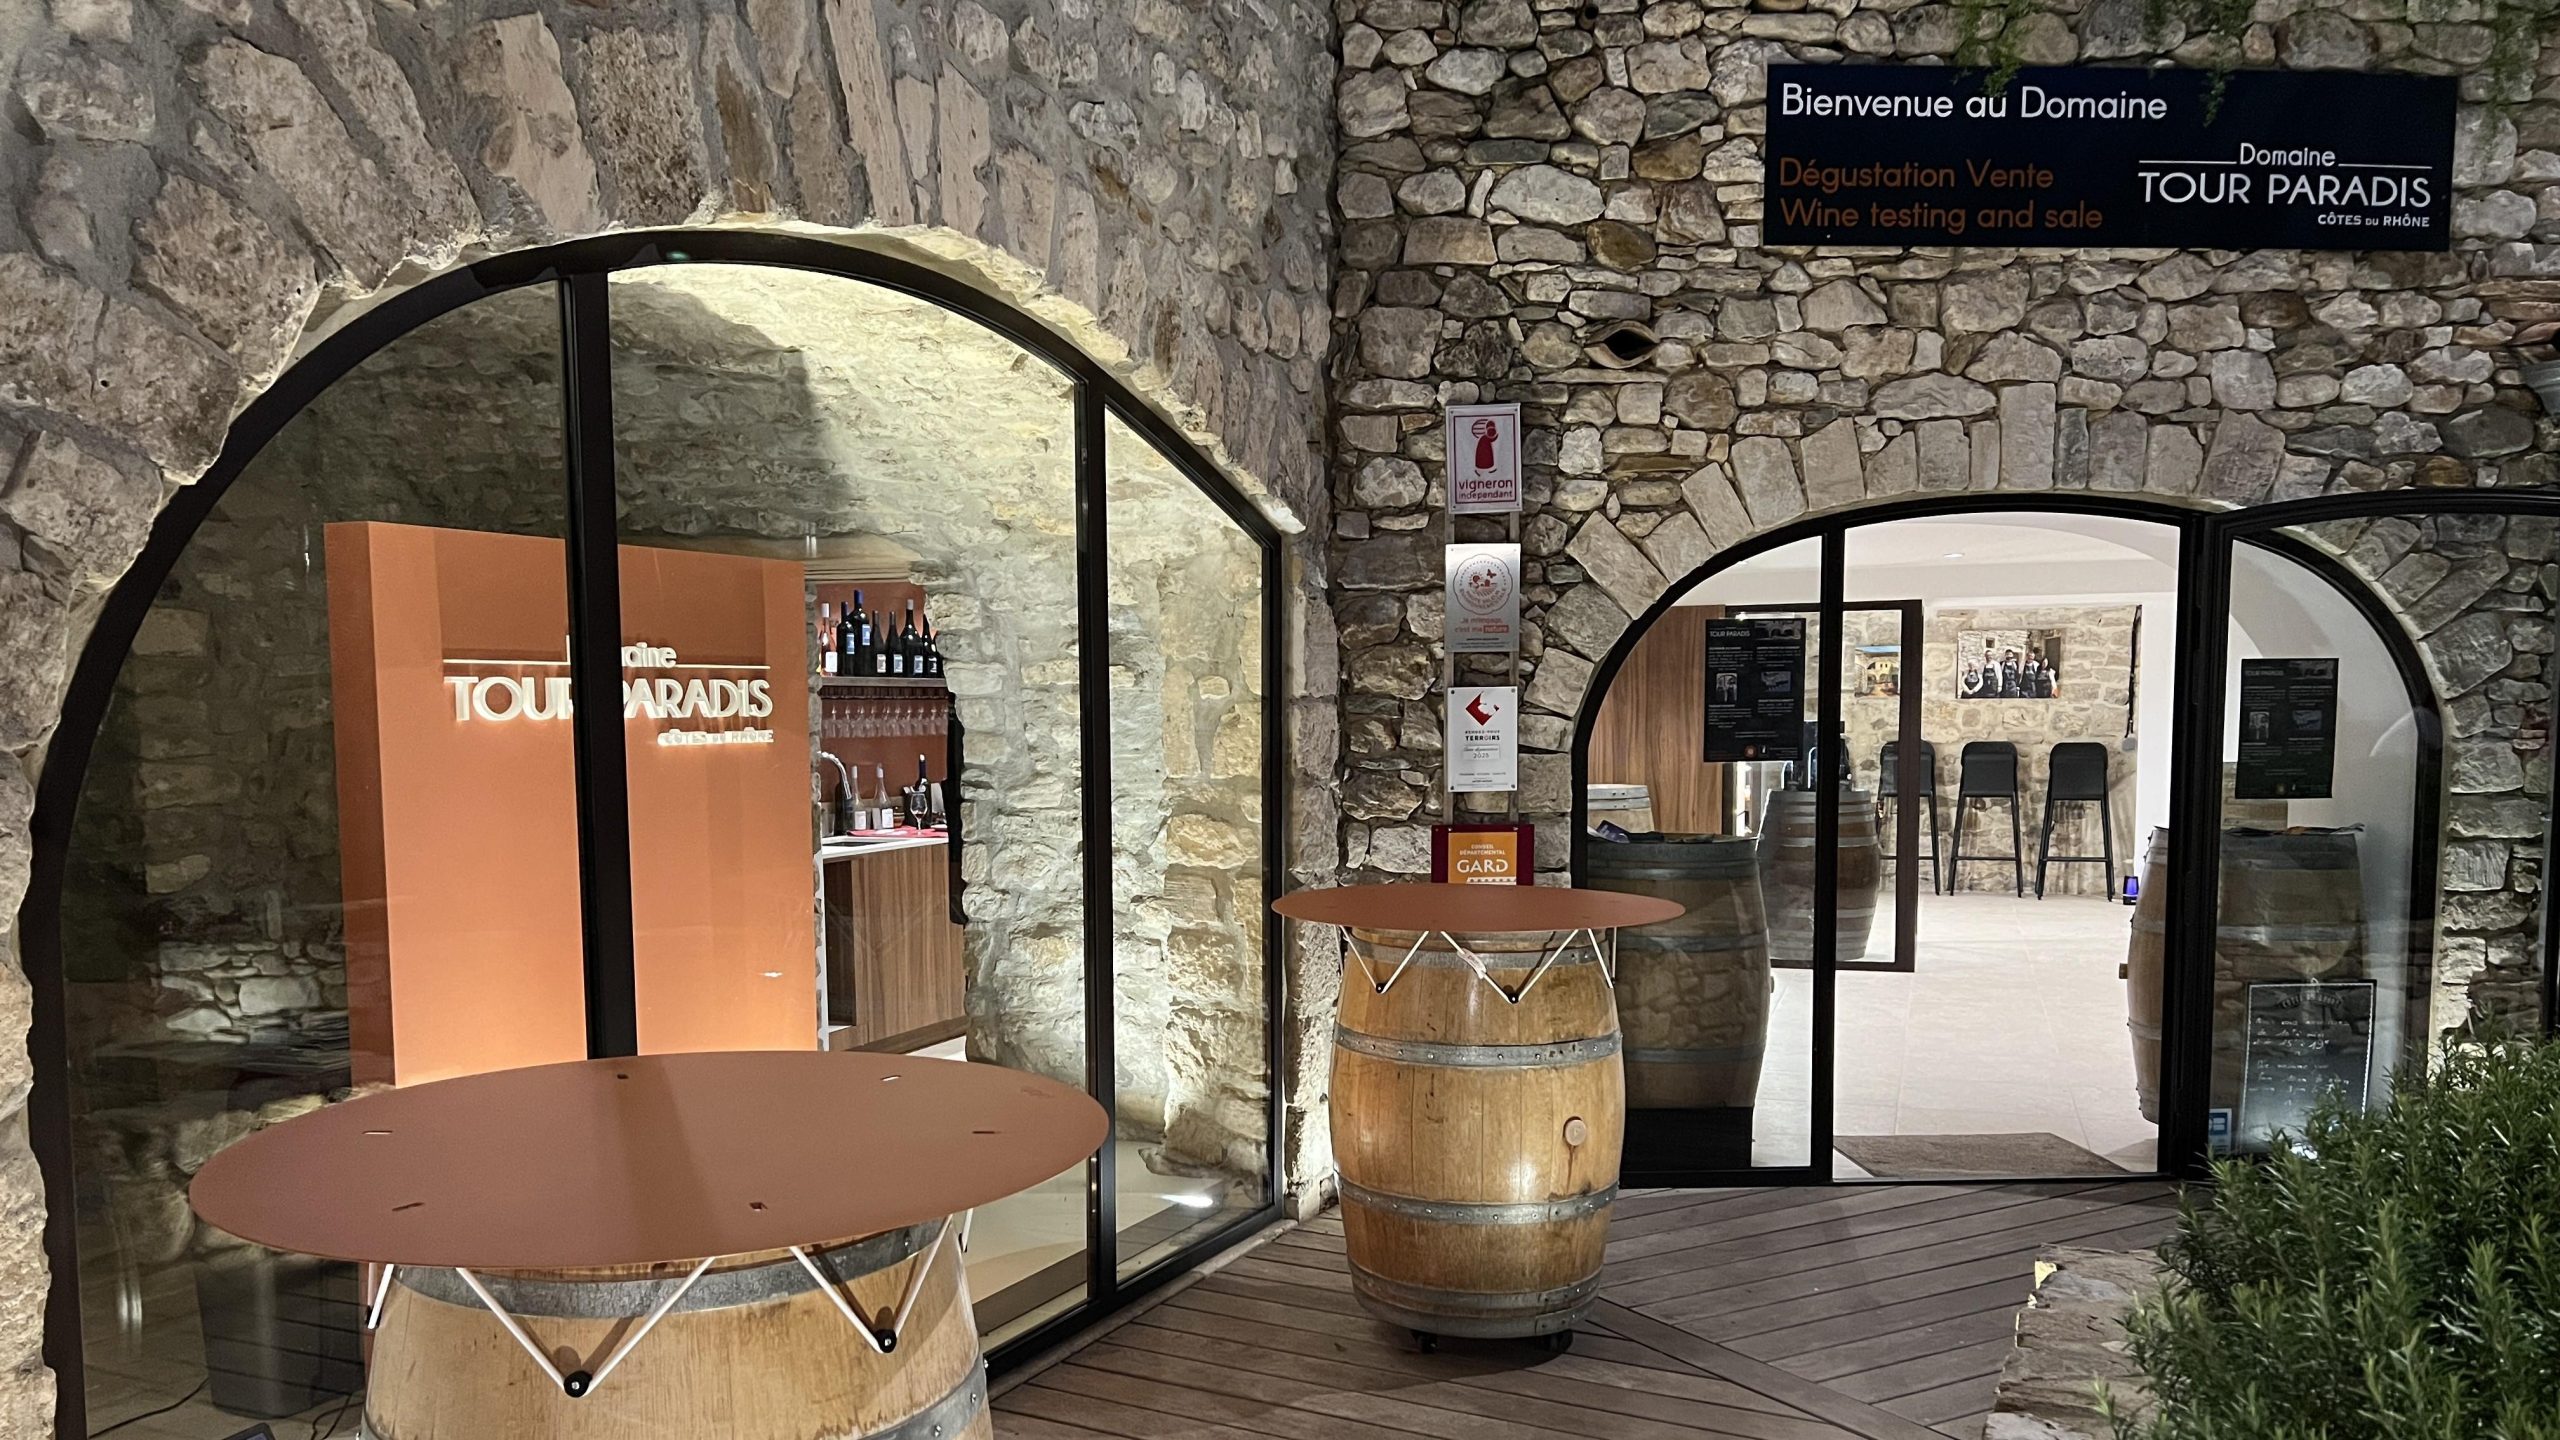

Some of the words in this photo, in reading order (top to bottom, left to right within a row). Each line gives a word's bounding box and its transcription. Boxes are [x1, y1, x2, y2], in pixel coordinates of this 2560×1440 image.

[1781, 83, 1954, 118] Bienvenue
[1965, 96, 2007, 118] au
[2020, 86, 2167, 120] Domaine
[2239, 142, 2336, 167] Domaine
[1780, 156, 1955, 194] Dégustation
[1966, 158, 2054, 188] Vente
[2138, 172, 2251, 204] TOUR
[2268, 173, 2431, 208] PARADIS
[1780, 197, 1860, 227] Wine
[1871, 202, 1967, 235] testing
[1977, 200, 2035, 229] and
[2045, 199, 2103, 229] sale
[2317, 211, 2362, 226] CÔTES
[2382, 212, 2430, 228] RHÔNE
[1458, 479, 1513, 493] vigneron
[1456, 858, 1509, 874] GARD
